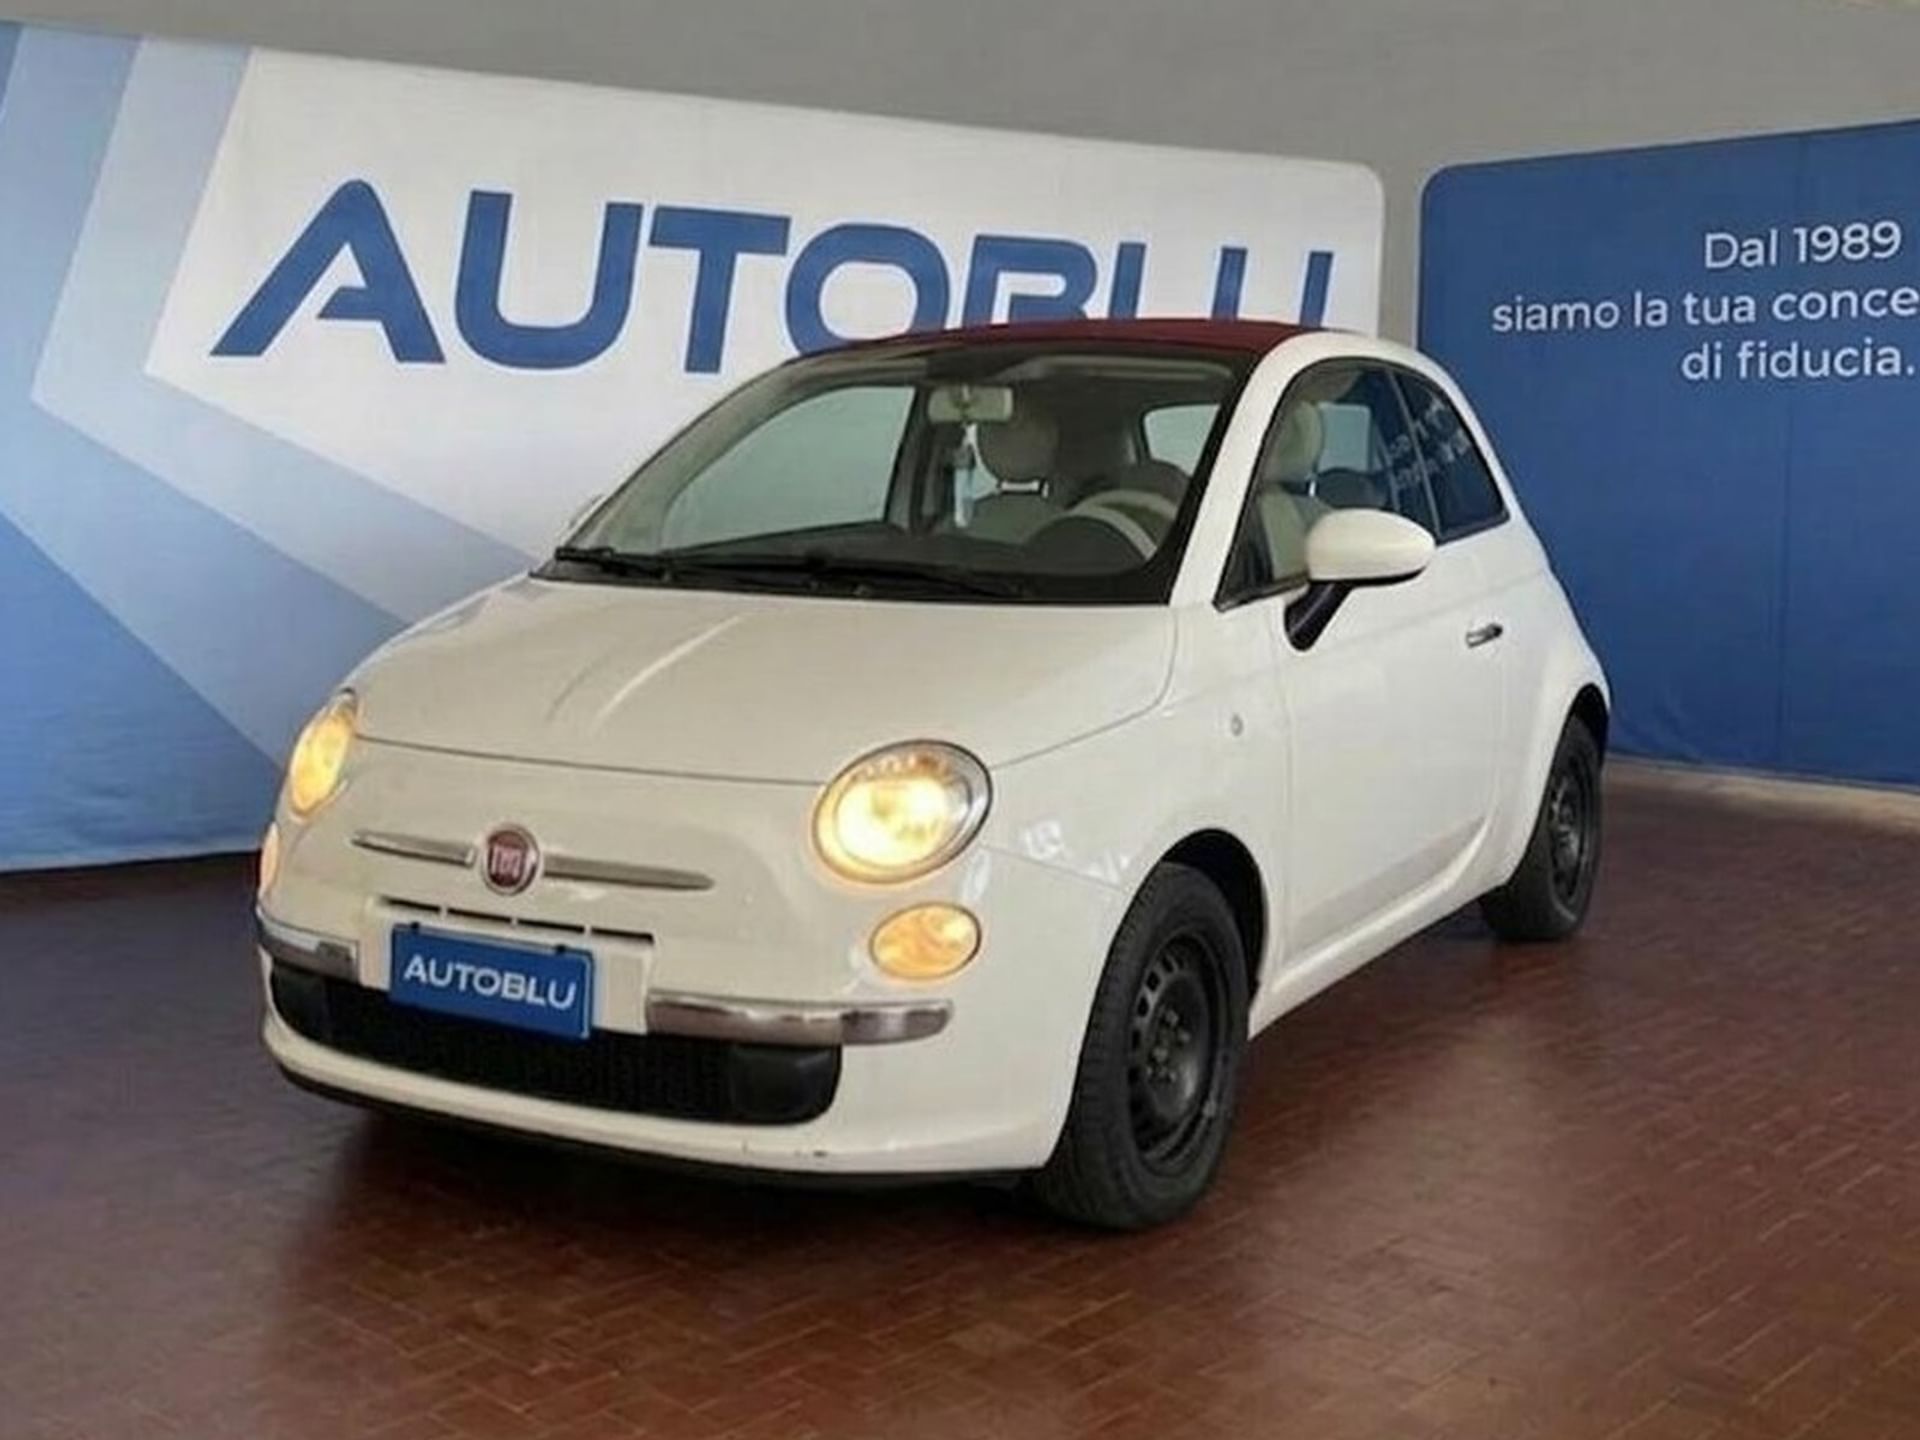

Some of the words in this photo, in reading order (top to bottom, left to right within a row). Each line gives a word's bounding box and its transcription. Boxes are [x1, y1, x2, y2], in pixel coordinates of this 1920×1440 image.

[1704, 228, 1778, 269] Dal
[1793, 220, 1902, 263] 1989
[1492, 295, 1620, 332] siamo
[1634, 291, 1668, 327] la
[1683, 292, 1756, 325] tua
[1771, 286, 1920, 321] conce
[1681, 341, 1722, 380] di
[1736, 336, 1915, 379] fiducia.
[404, 954, 576, 1010] AUTOBLU
